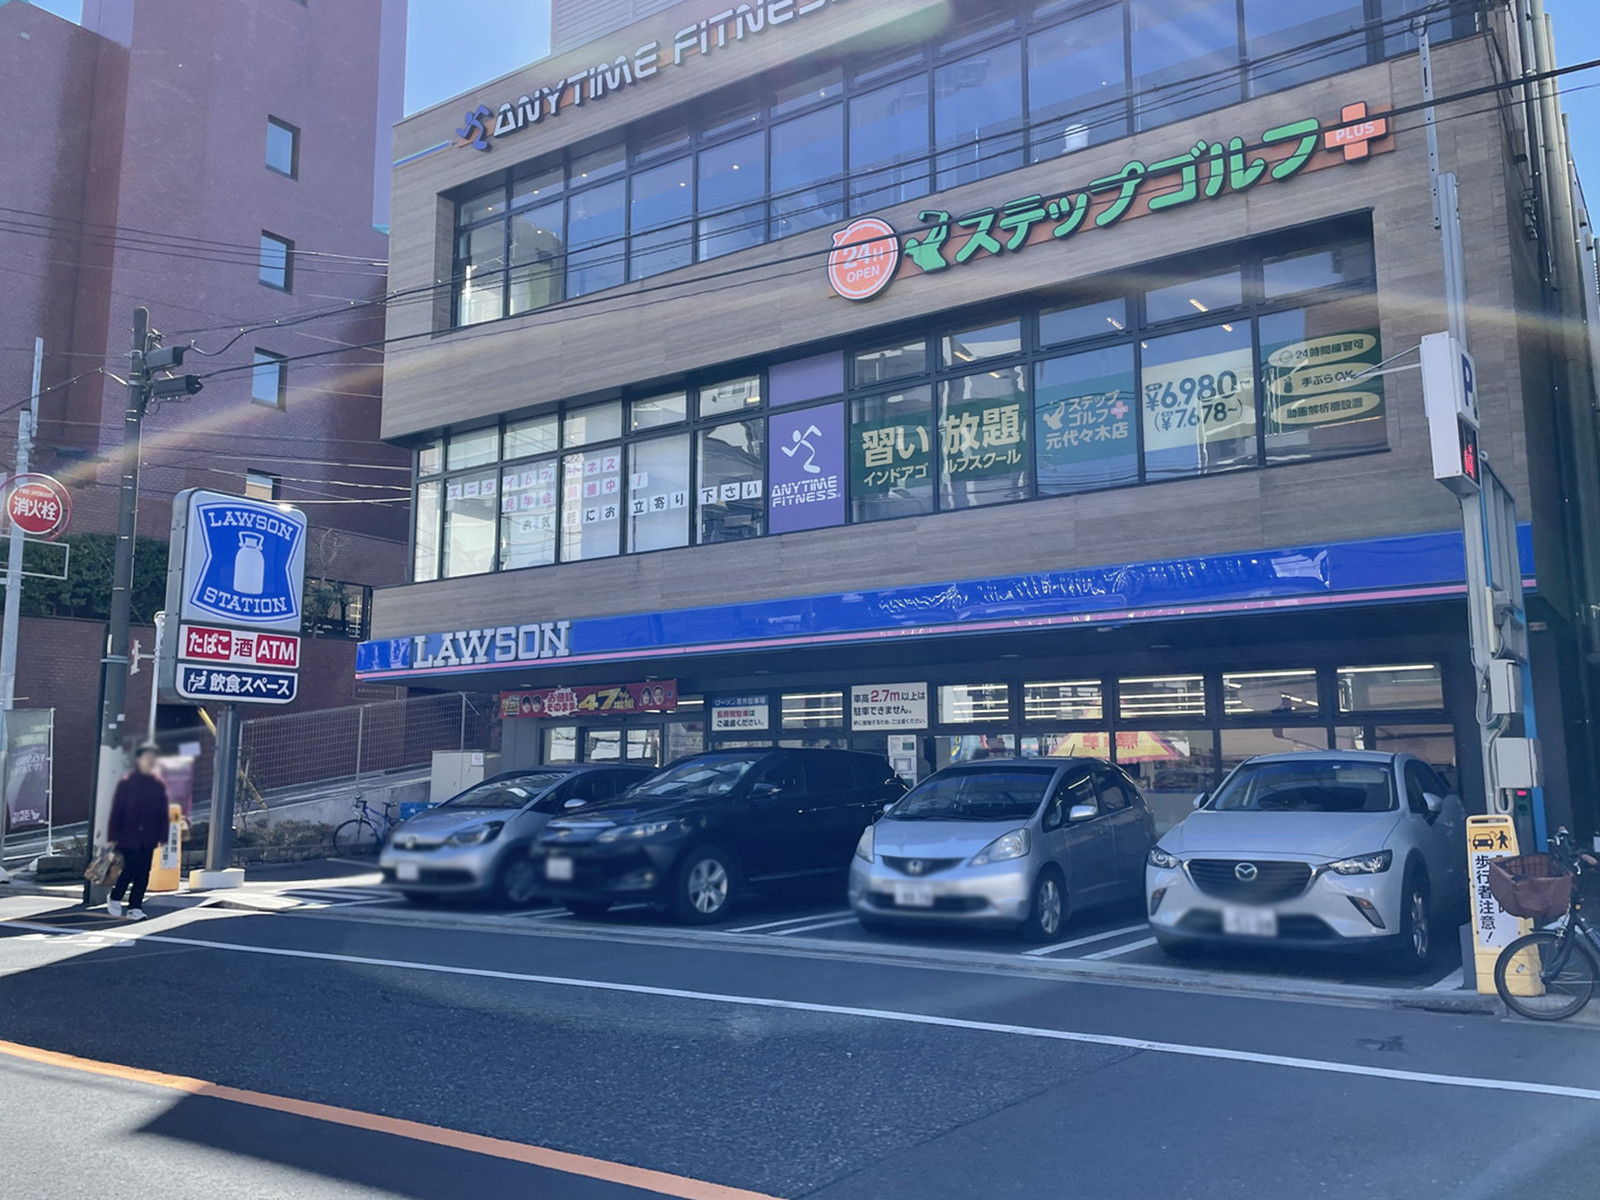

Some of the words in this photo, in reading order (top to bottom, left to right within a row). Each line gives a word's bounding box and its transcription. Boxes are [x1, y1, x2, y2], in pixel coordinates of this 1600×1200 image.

[494, 42, 658, 137] ANYTIME
[1335, 121, 1375, 142] PLUS
[955, 117, 1319, 263] ステップゴルフ
[846, 265, 880, 283] OPEN
[1461, 353, 1474, 407] P
[1068, 390, 1120, 412] ステップ
[1068, 409, 1109, 427] ゴルフ
[1045, 421, 1129, 450] 元代々木店
[772, 475, 837, 497] ANYTIME
[772, 488, 837, 508] FITNESS
[13, 496, 58, 521] 消火栓
[208, 511, 293, 541] LAWSON
[203, 587, 288, 613] STATION
[189, 632, 231, 655] たばこ
[234, 637, 253, 658] 酒
[257, 638, 295, 661] ATM
[413, 620, 571, 669] LAWSON
[210, 673, 290, 696] 飲食スペース
[1475, 854, 1496, 943] 歩行者注意!
